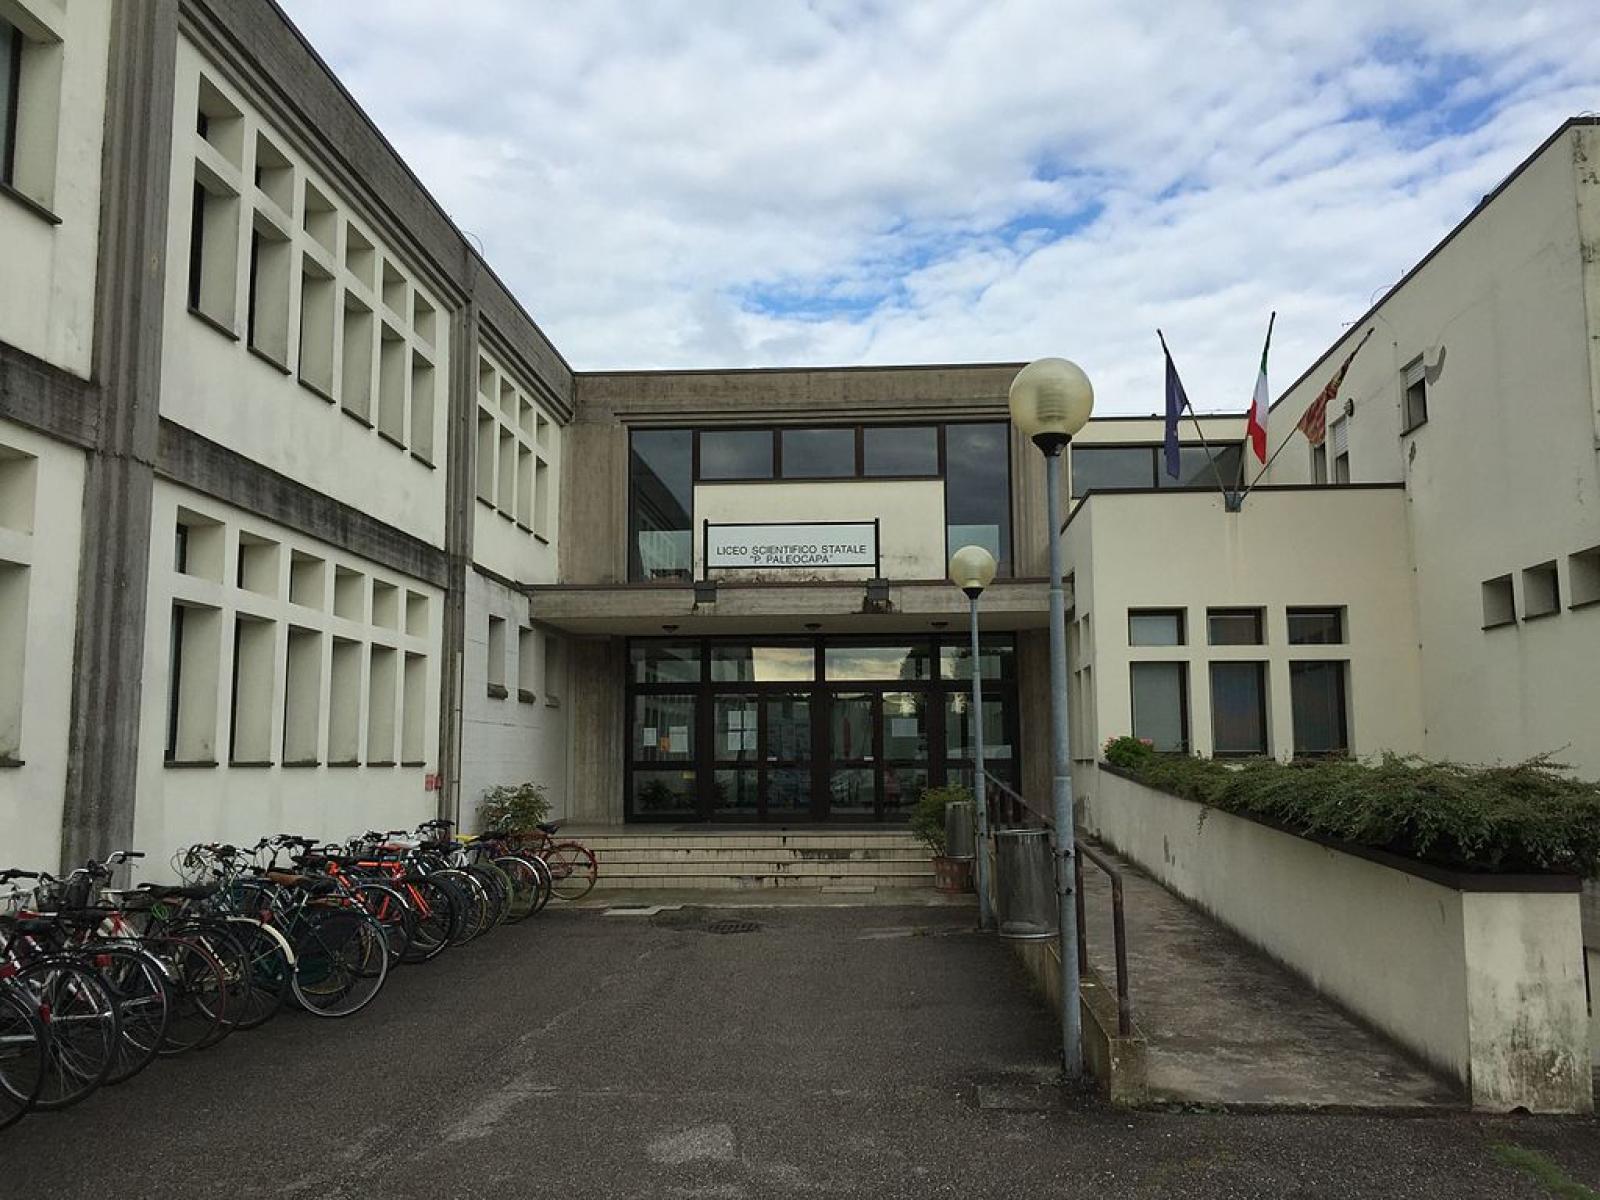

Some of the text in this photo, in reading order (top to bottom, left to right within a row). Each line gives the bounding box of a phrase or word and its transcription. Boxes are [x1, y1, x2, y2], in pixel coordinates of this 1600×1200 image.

[716, 544, 867, 556] LICEO SCIENTIFICO STATALE
